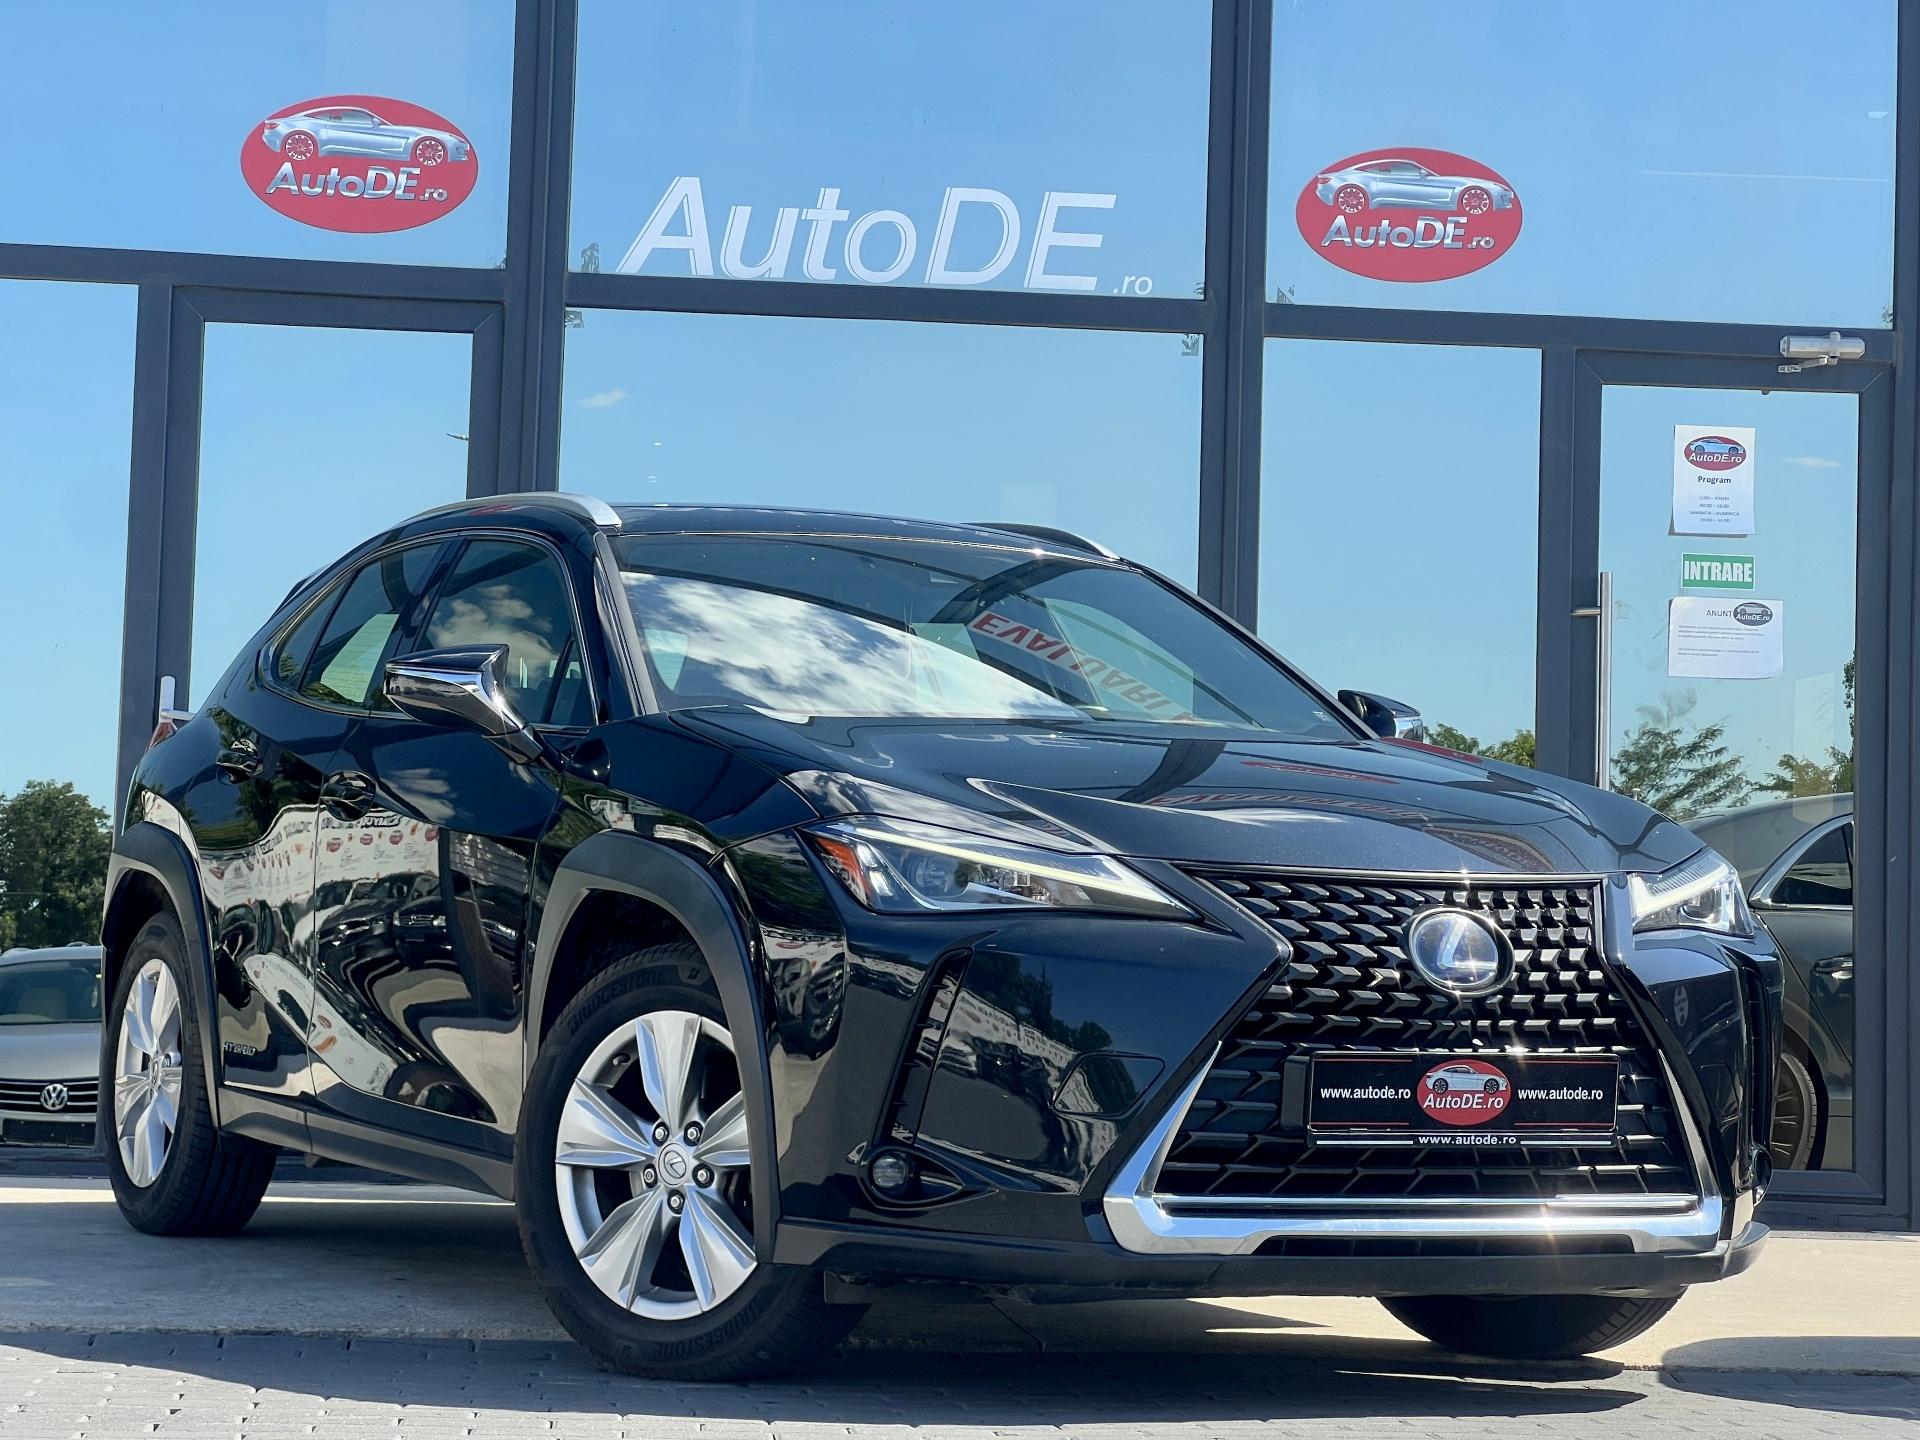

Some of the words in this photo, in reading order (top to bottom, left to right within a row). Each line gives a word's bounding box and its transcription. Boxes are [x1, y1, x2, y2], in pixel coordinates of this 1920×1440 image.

[1688, 452, 1743, 464] AutoDE.ro
[1697, 475, 1732, 485] Program
[1682, 560, 1753, 583] INTRARE
[1320, 1085, 1411, 1100] www.autode.ro
[1518, 1087, 1604, 1101] www.autode.ro
[1423, 1093, 1504, 1110] AutoDE.ro
[1418, 1134, 1517, 1145] www.autode.ro
